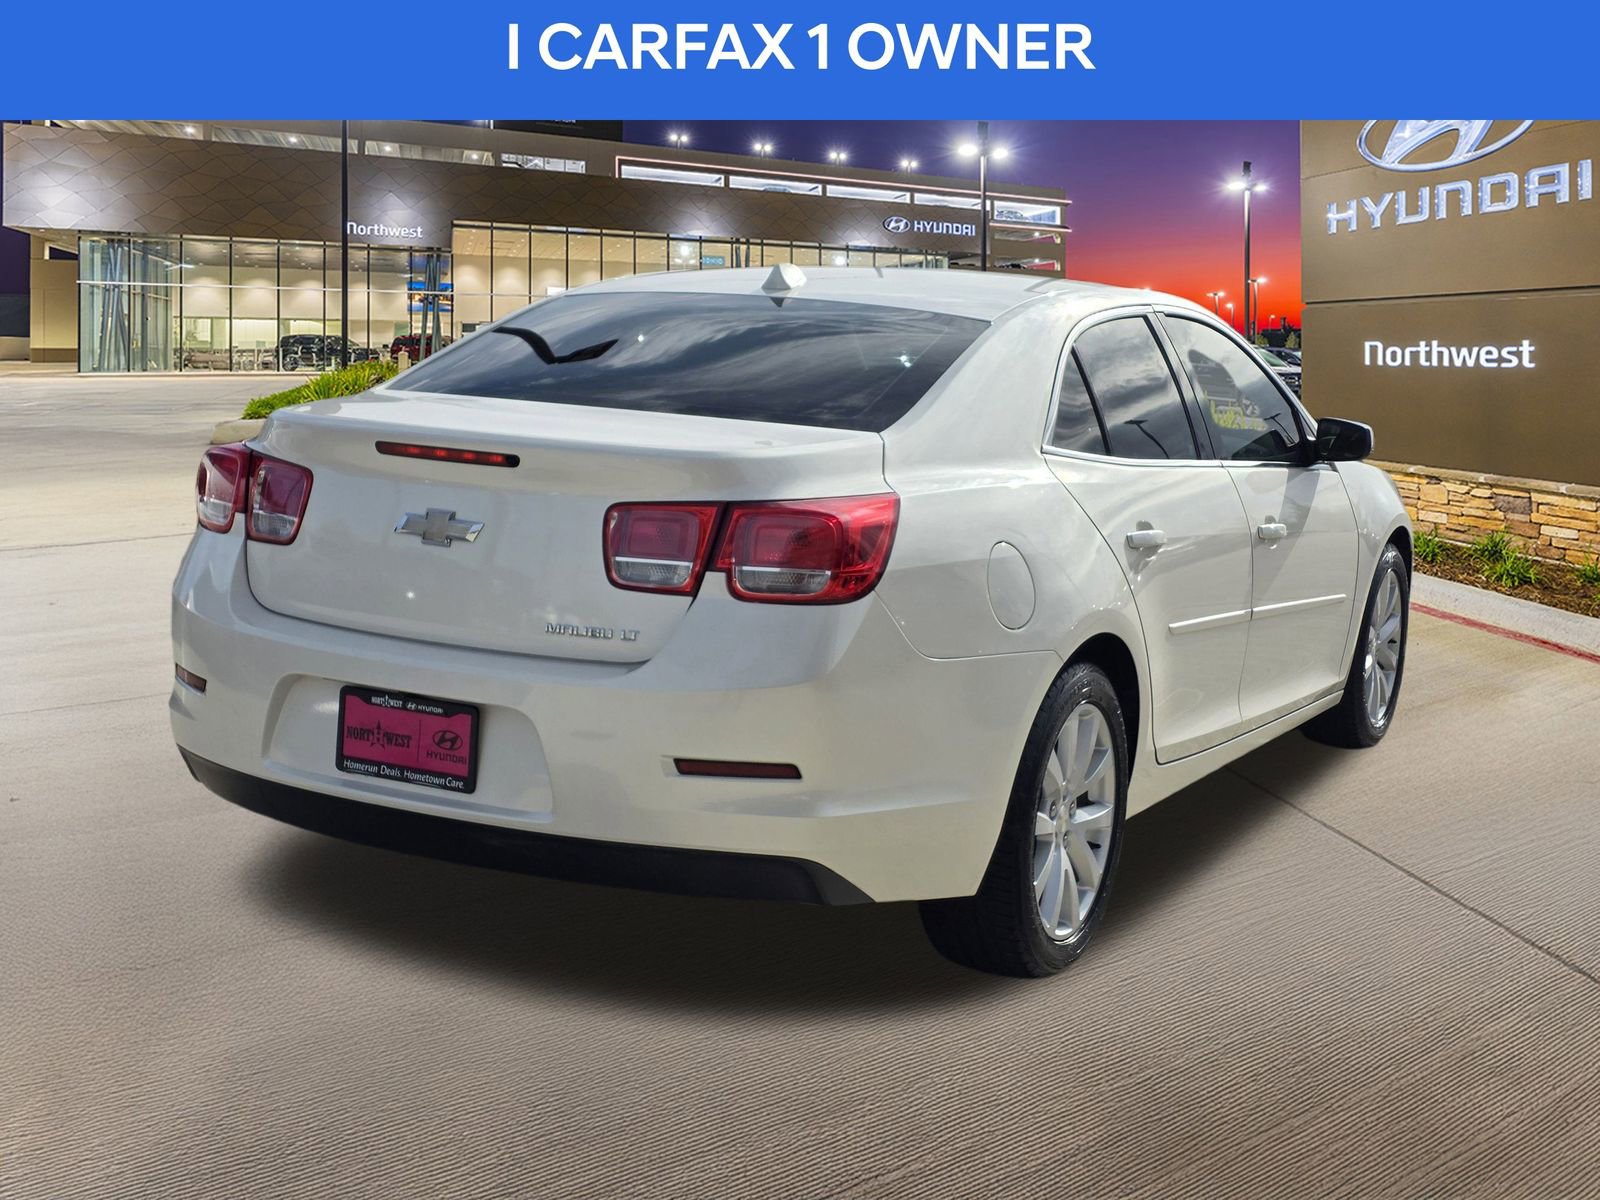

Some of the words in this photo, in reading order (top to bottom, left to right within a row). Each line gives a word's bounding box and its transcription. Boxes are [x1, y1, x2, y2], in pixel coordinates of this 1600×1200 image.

[1325, 158, 1593, 236] HYUNDAI
[346, 220, 424, 238] Northwest
[913, 219, 977, 237] HYUNDAI
[1363, 339, 1536, 369] Northwest
[545, 622, 613, 640] MALIBU
[620, 629, 641, 641] LT
[417, 705, 444, 714] HYUNDAI
[426, 751, 467, 765] HYUNDAI
[343, 759, 379, 774] Homerun
[403, 770, 446, 786] Hometown
